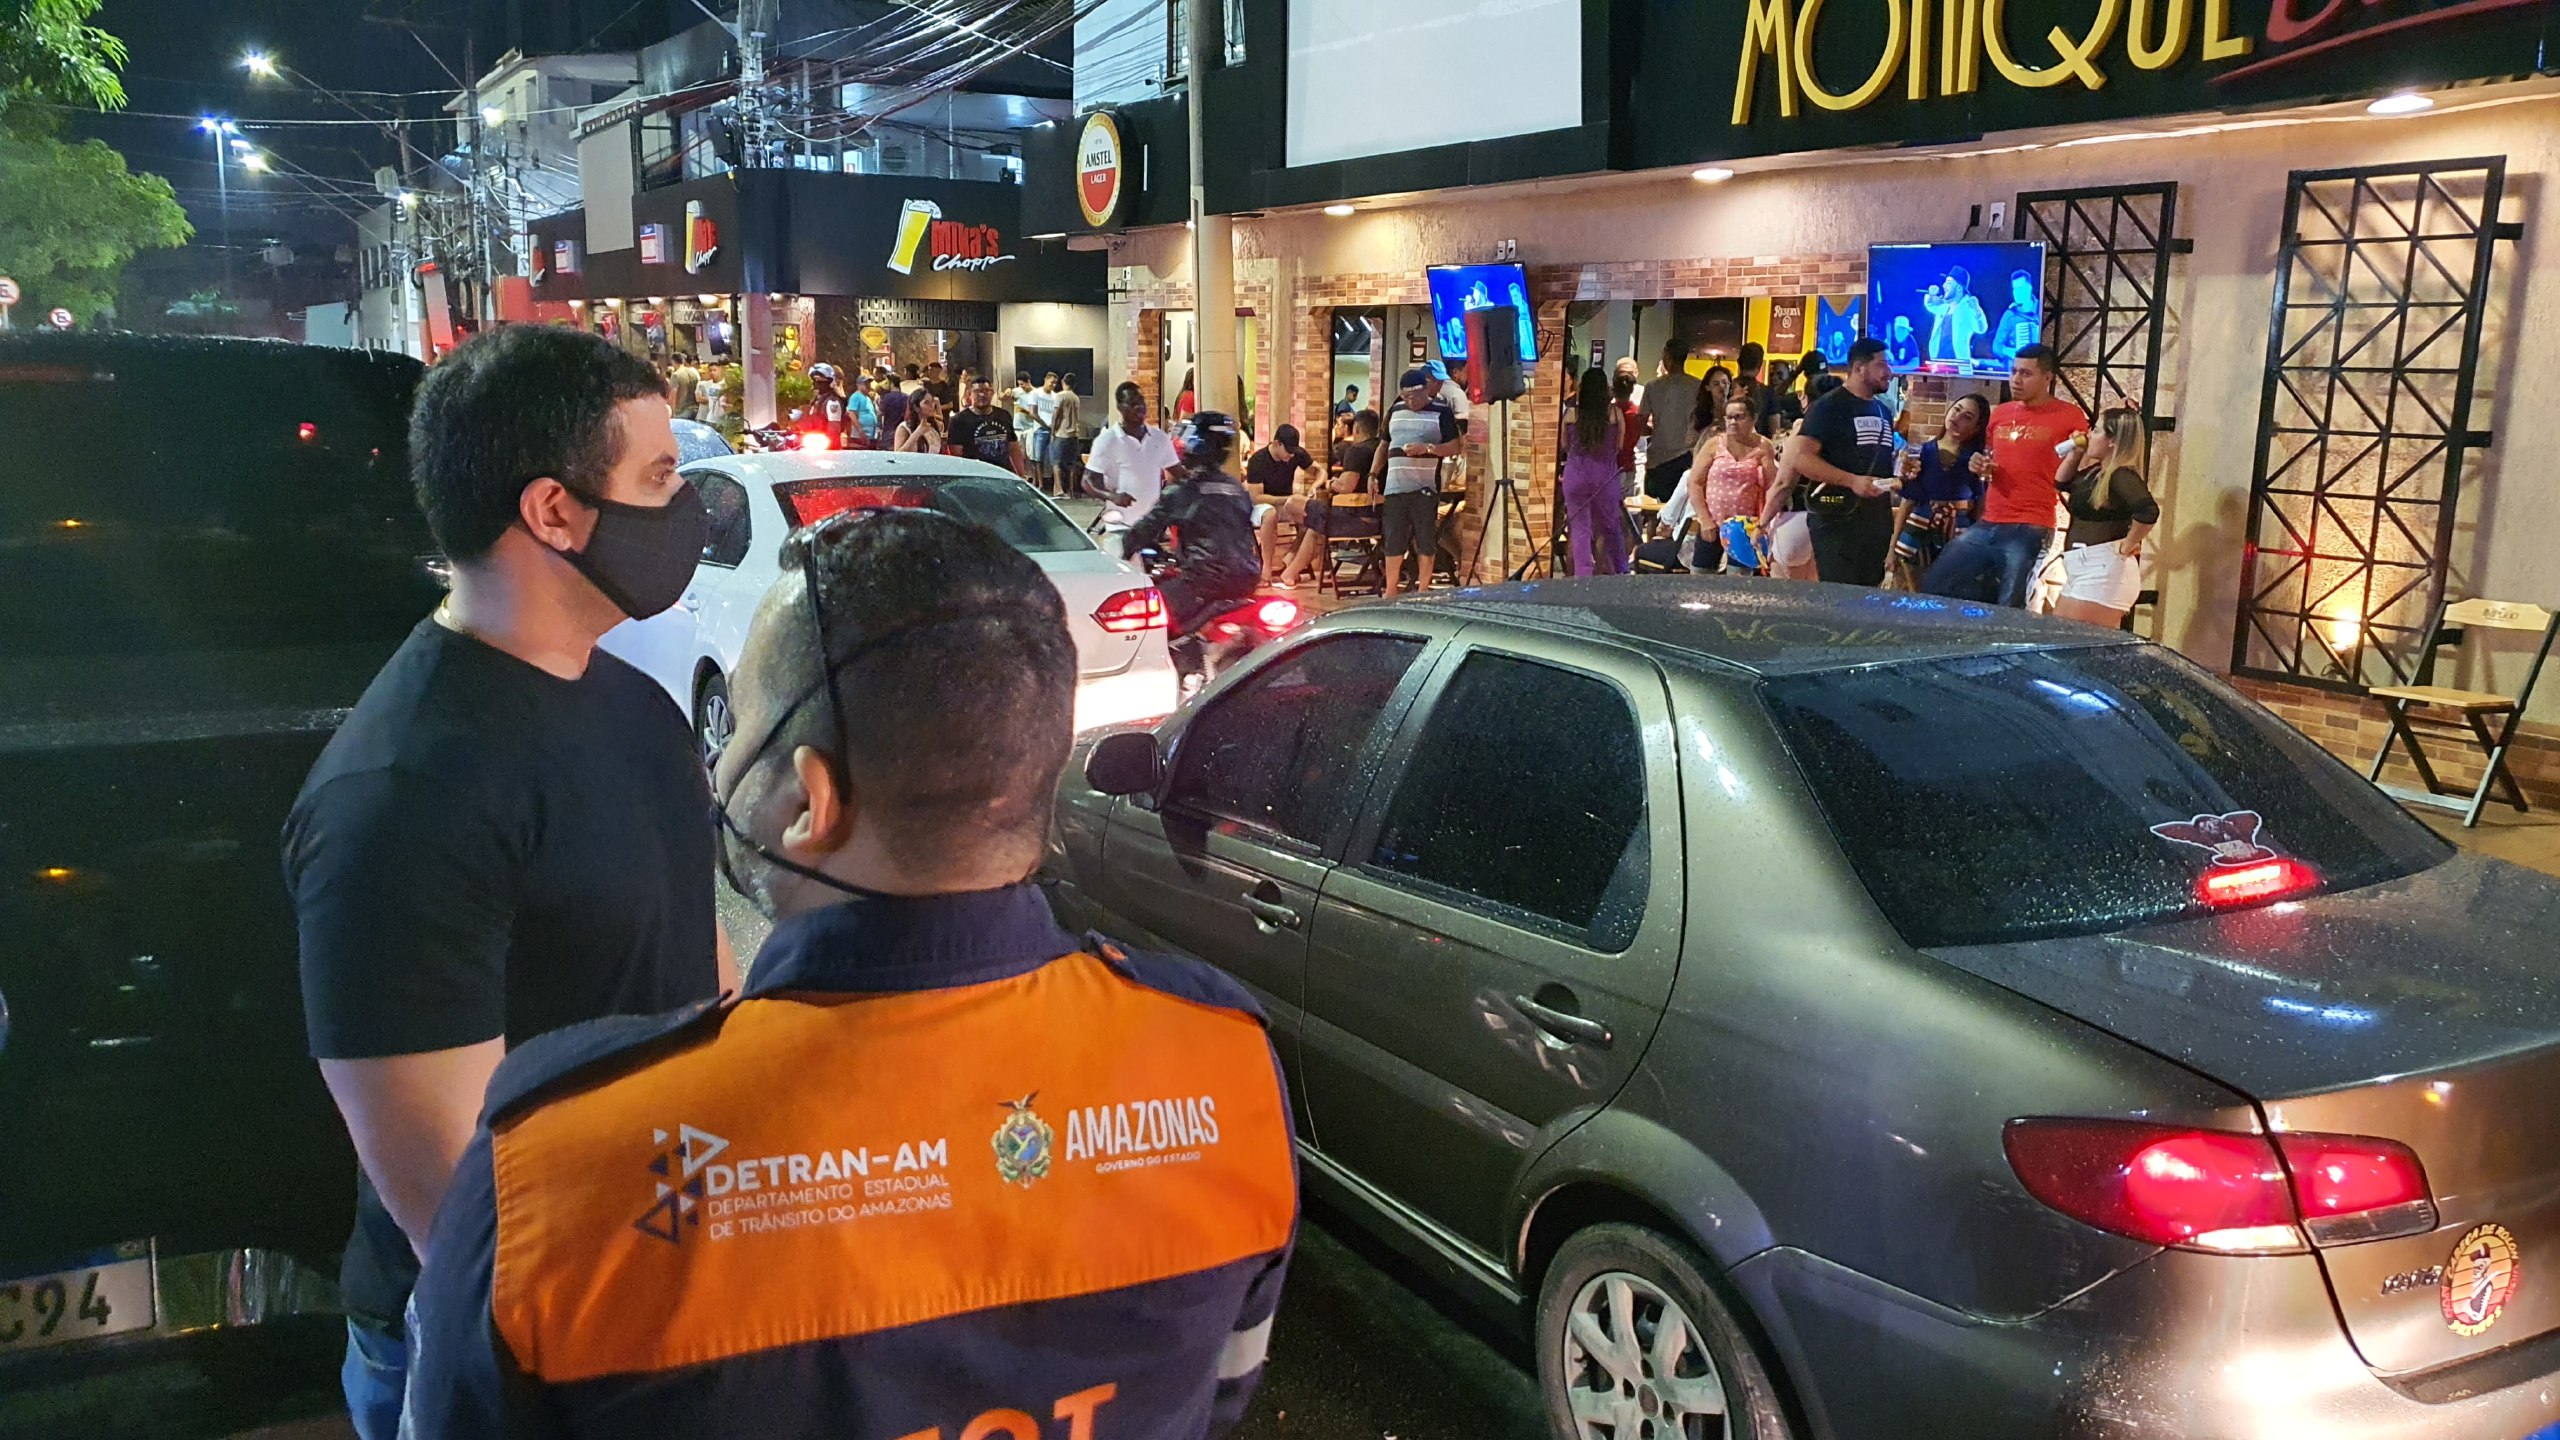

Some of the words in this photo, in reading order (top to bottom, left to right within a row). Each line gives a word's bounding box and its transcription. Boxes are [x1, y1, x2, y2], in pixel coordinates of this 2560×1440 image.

[1085, 149, 1113, 168] AMSTEL
[1090, 173, 1107, 185] LAGER
[932, 252, 1016, 272] Chopp
[1065, 1095, 1219, 1161] AMAZONAS
[706, 1138, 948, 1196] DETRAN-AM
[1095, 1156, 1145, 1174] GOVERNO
[1146, 1154, 1162, 1166] DO
[1163, 1150, 1201, 1164] ESTADO
[707, 1183, 853, 1218] DEPARTAMENTO
[863, 1172, 949, 1197] ESTADUAL
[709, 1220, 735, 1241] DE
[739, 1208, 824, 1235] TRÂNSITO
[827, 1205, 856, 1224] DO
[859, 1193, 952, 1217] AMAZONAS
